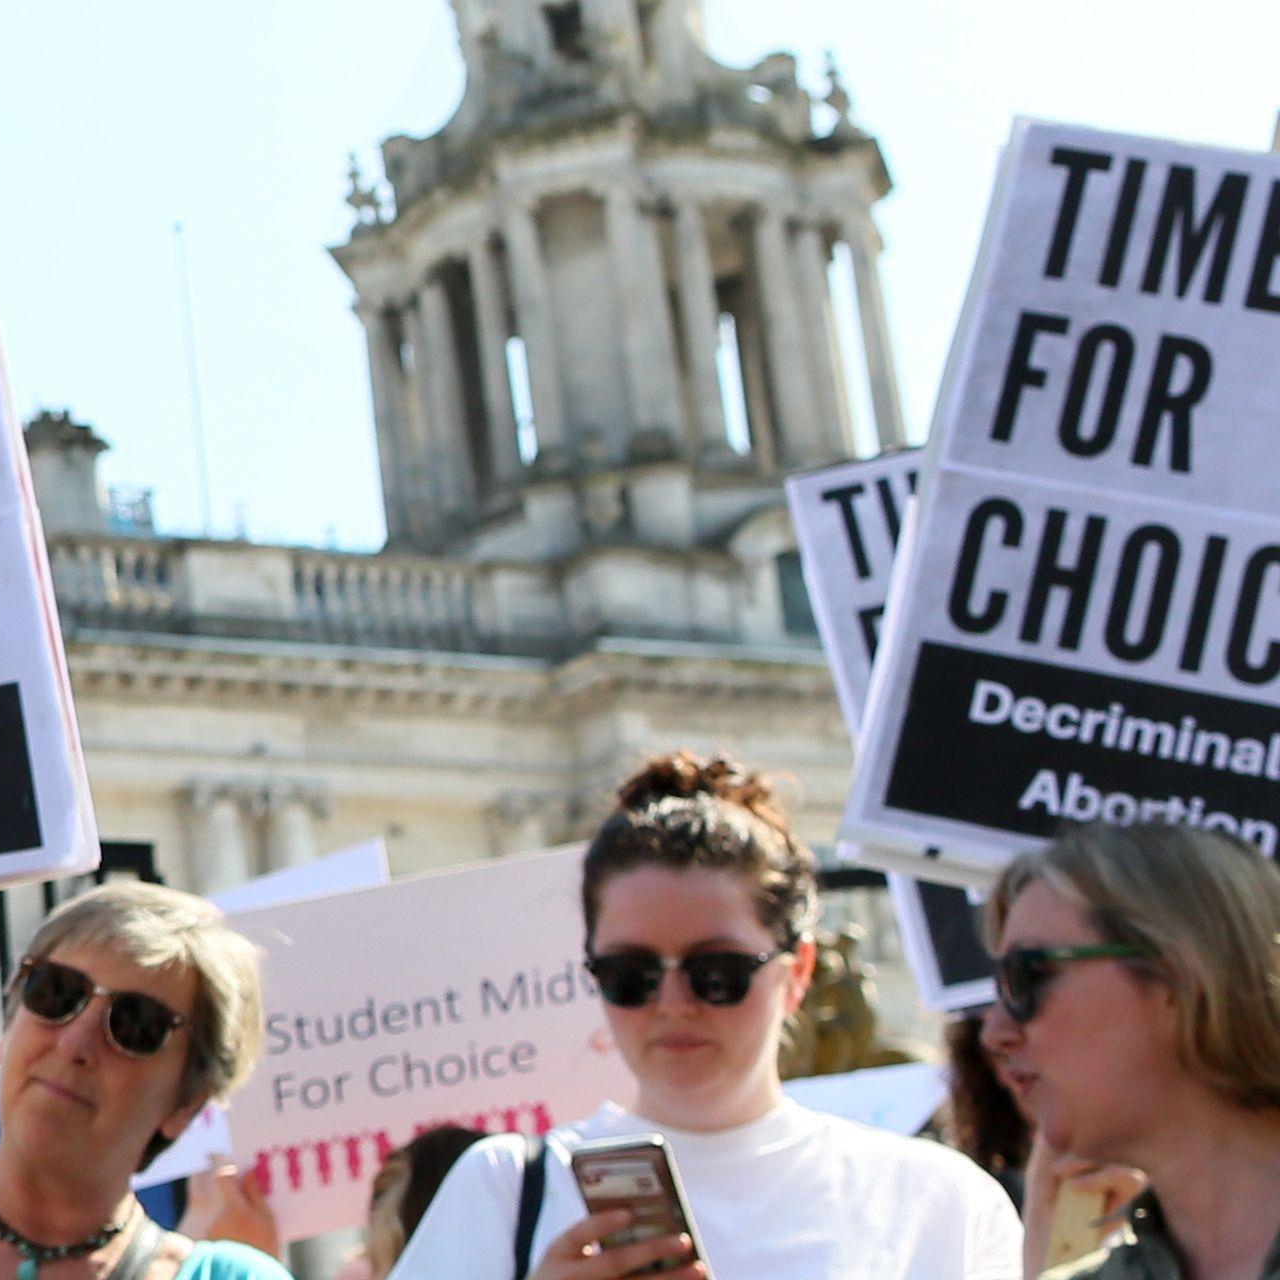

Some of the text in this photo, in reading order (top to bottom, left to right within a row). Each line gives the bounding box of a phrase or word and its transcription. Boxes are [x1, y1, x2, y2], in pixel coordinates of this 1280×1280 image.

[1045, 147, 1280, 314] TIME
[989, 313, 1212, 475] FOR
[821, 472, 917, 578] TI
[948, 497, 1280, 686] CHOIC
[969, 679, 1280, 780] Decriminal
[266, 988, 463, 1056] Student
[272, 1038, 538, 1114] For Choice
